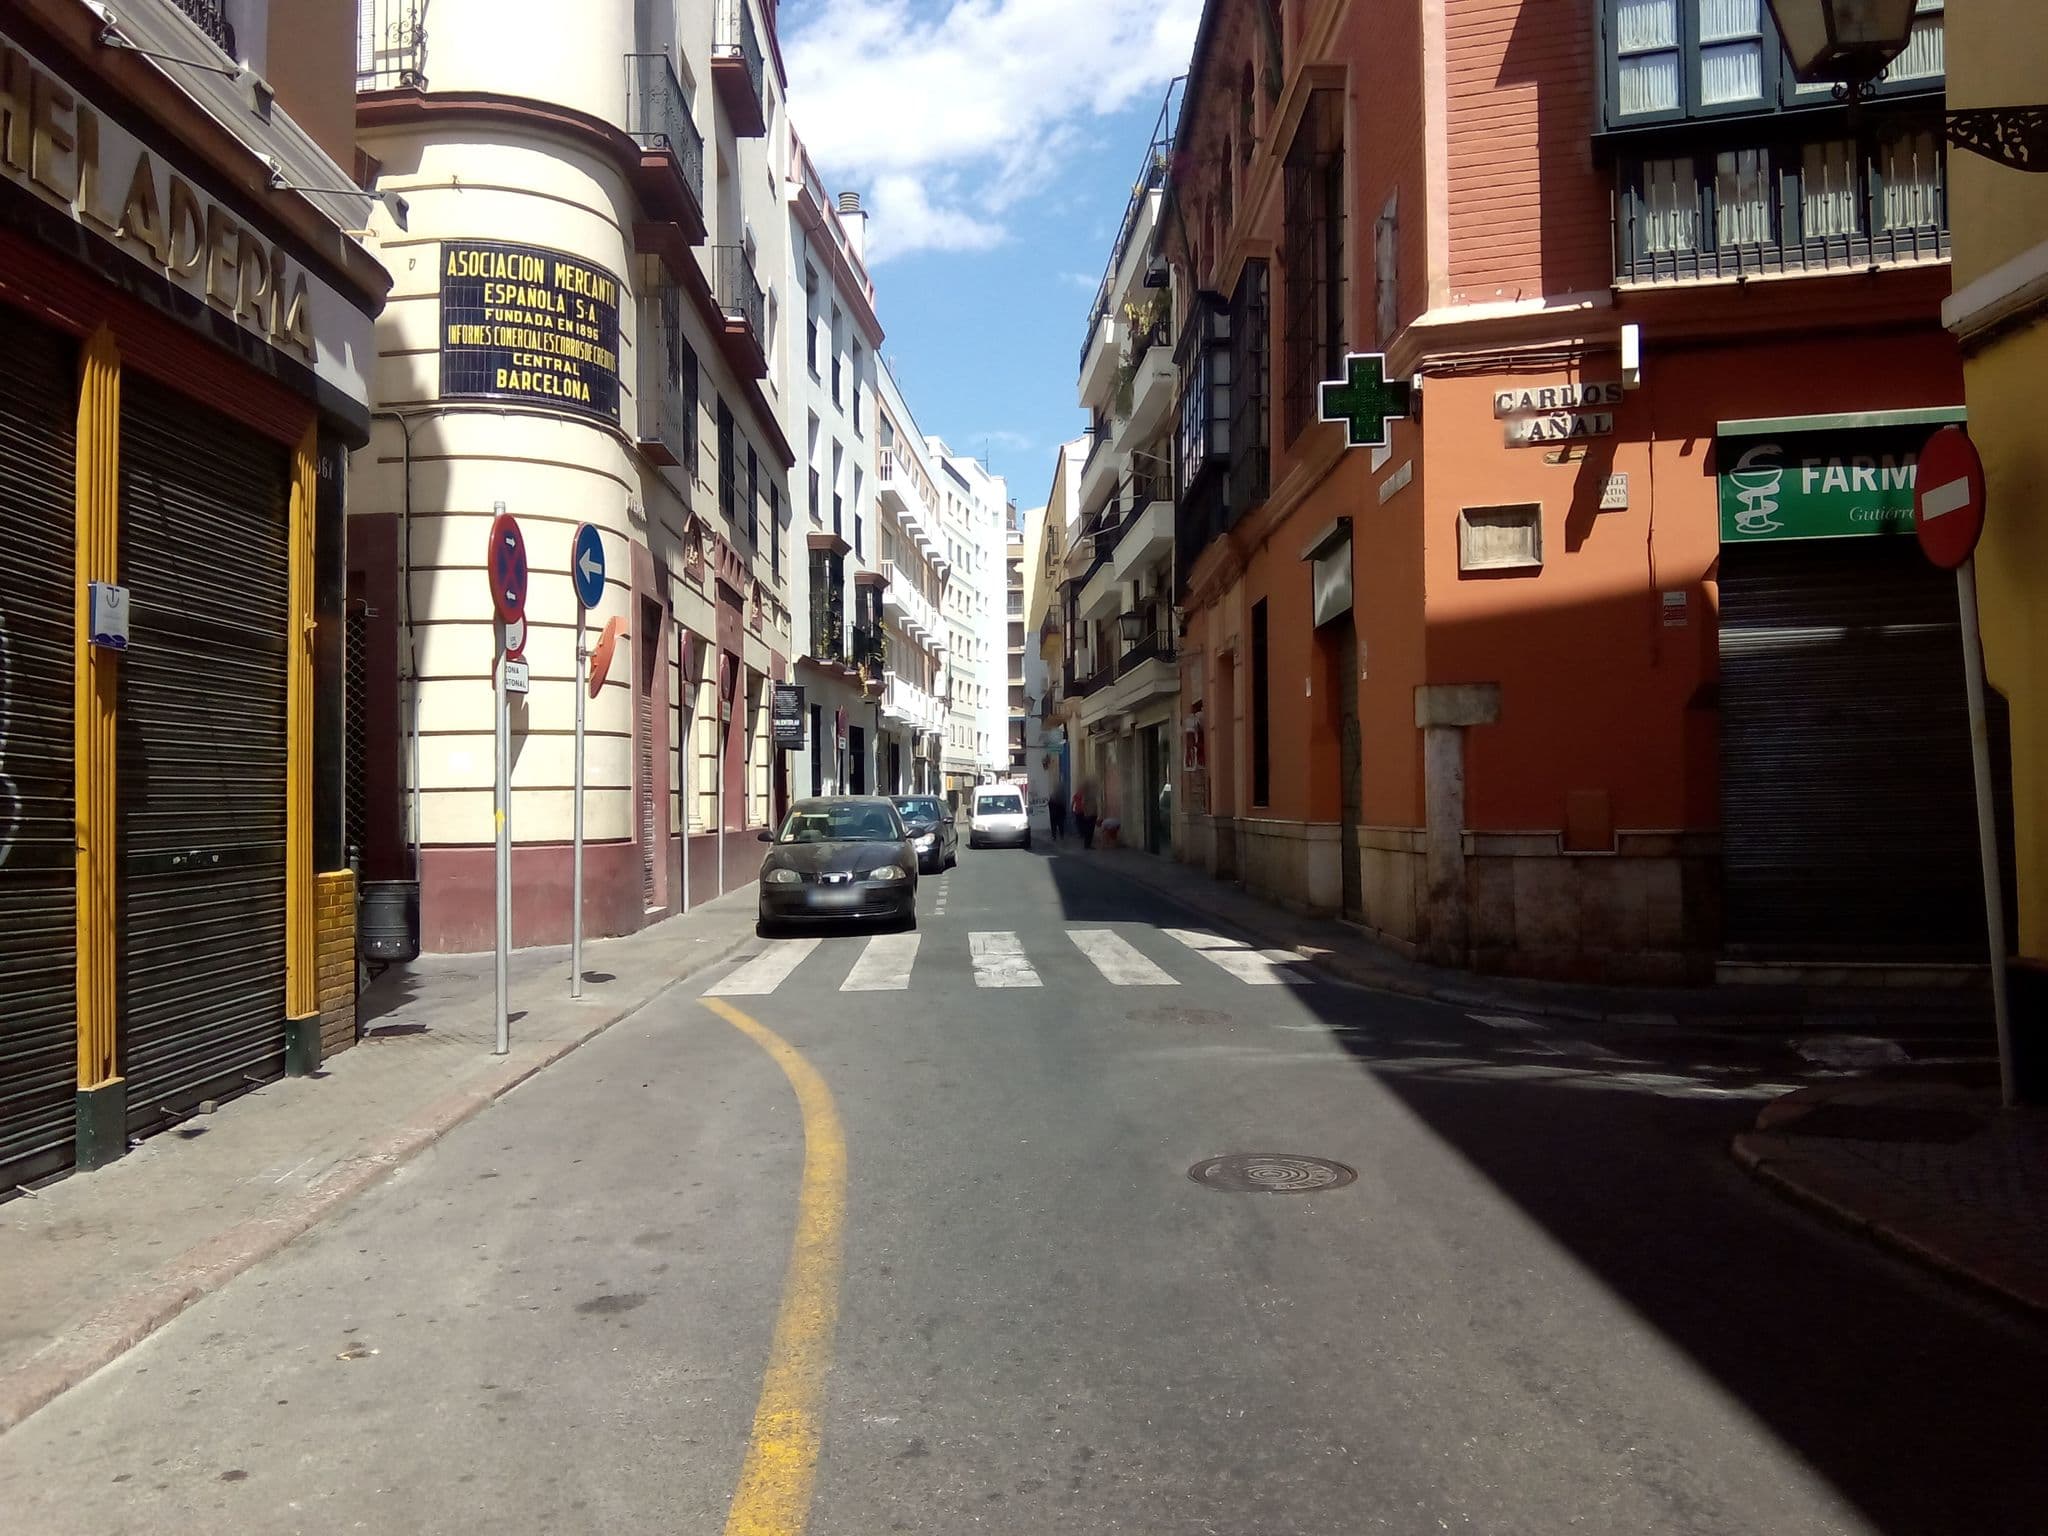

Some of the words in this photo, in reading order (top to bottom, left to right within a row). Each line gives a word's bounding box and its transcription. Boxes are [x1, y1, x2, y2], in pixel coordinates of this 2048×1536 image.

[484, 281, 566, 314] ESPAÑOLA
[554, 261, 617, 310] MERCANTIL
[447, 324, 492, 346] INFORMES
[494, 325, 555, 353] COMERCIALES
[485, 308, 554, 329] FUNDADA
[557, 318, 573, 333] EN
[575, 322, 600, 341] 1896
[512, 352, 581, 377] CENTRAL
[496, 368, 591, 403] BARCELONA
[1496, 383, 1622, 411] CARLOS
[1518, 412, 1613, 441] AÑAL
